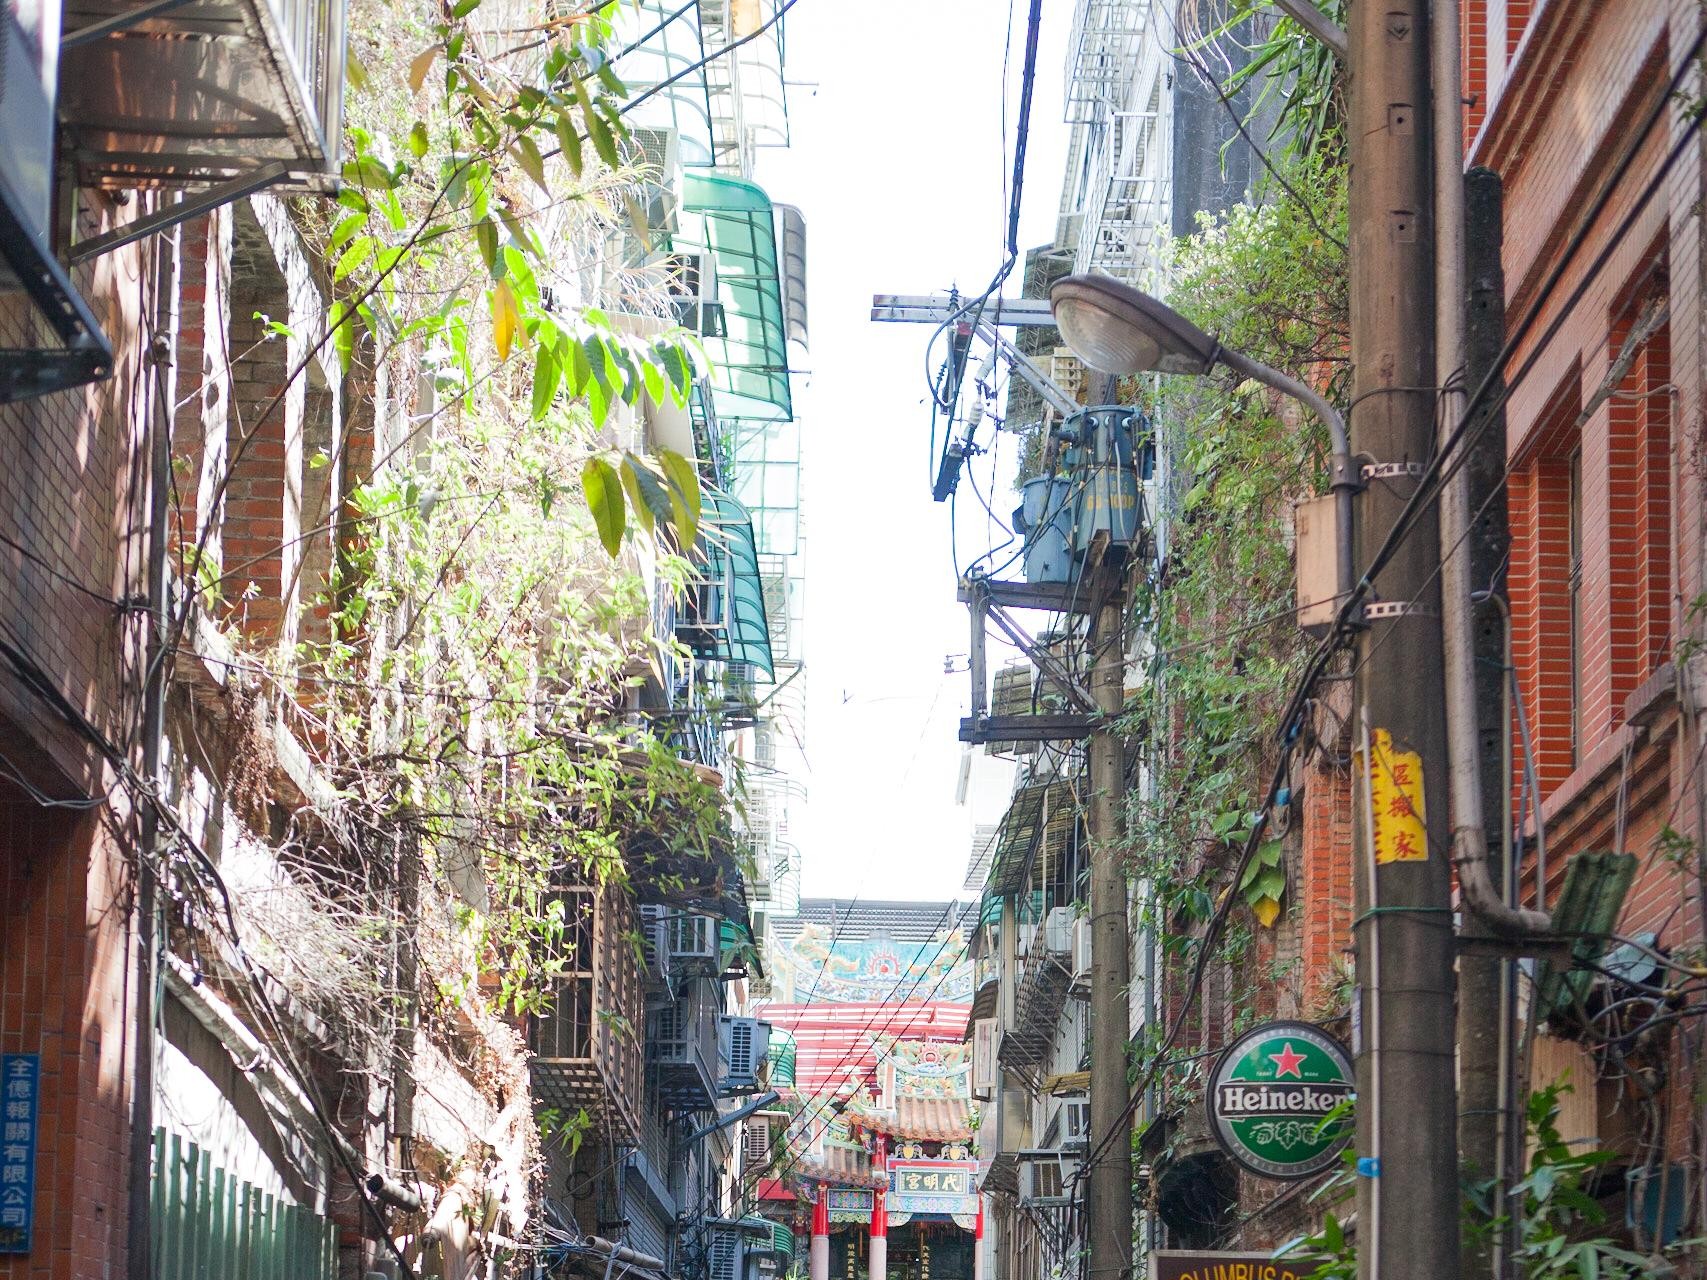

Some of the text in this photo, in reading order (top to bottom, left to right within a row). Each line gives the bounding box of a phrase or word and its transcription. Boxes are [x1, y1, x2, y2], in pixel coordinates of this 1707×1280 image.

[1387, 763, 1419, 858] 區搬家
[2, 1059, 33, 1227] 全億報關有限公司
[906, 1173, 960, 1191] 代明宮
